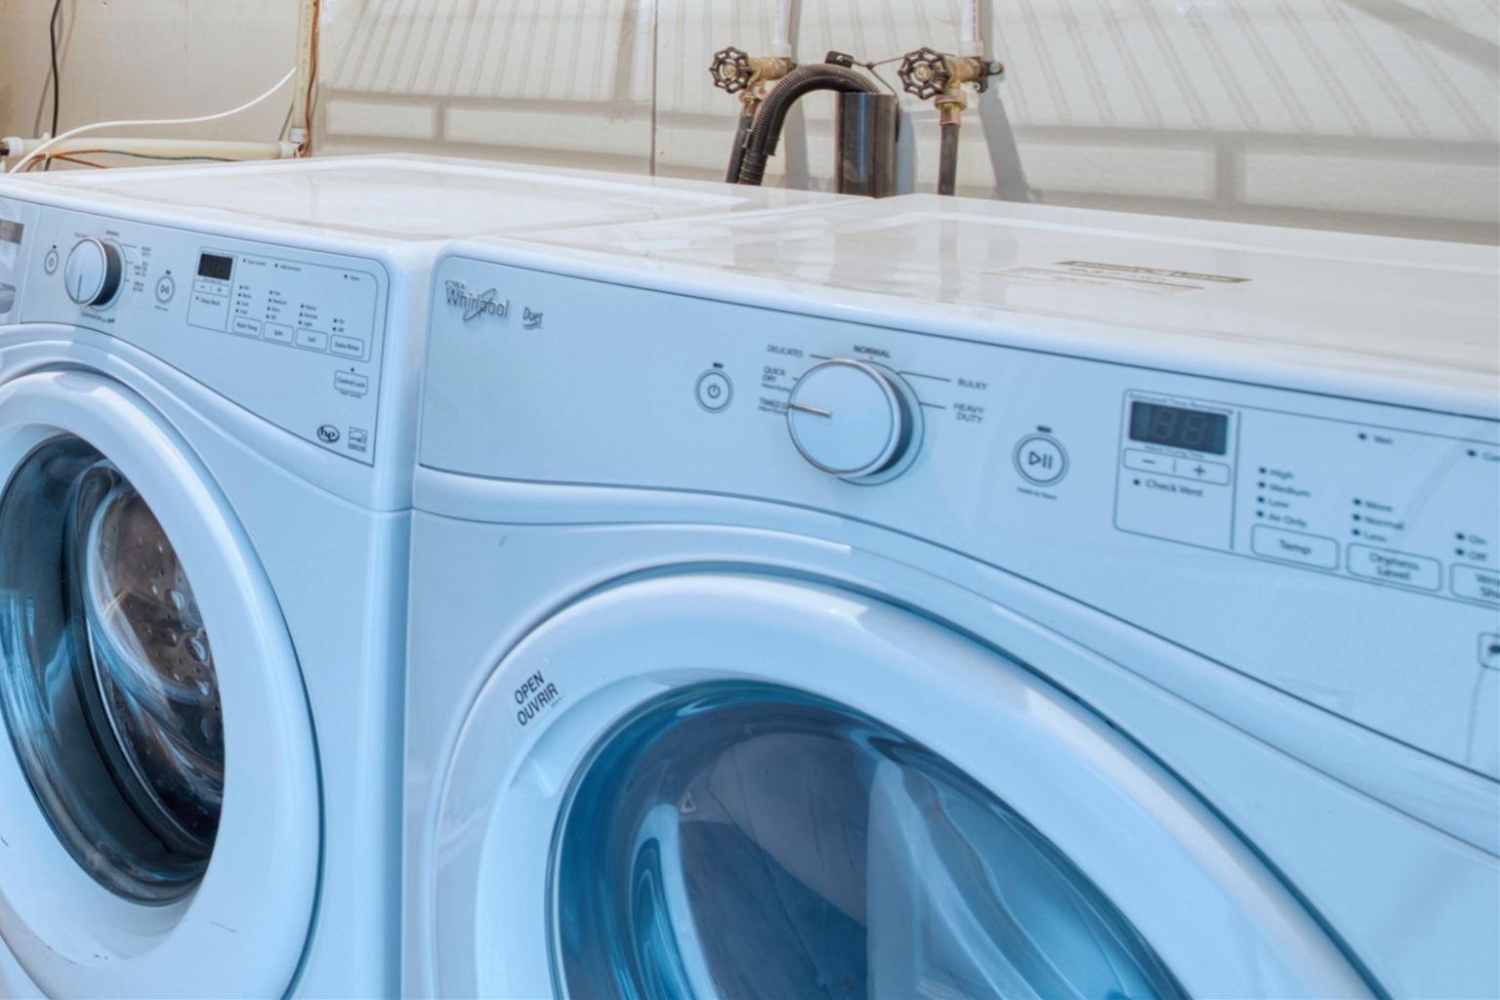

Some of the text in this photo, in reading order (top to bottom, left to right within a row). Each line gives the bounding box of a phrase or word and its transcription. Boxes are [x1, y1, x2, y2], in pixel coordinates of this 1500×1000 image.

[445, 280, 511, 322] Whirlpool
[766, 345, 804, 358] DELICATES
[853, 344, 892, 359] NORMAL
[762, 374, 777, 384] DRY
[763, 366, 787, 377] QUICK
[957, 377, 990, 391] BULKY
[952, 402, 986, 415] HEAVY
[956, 413, 984, 425] DUTY
[1269, 466, 1295, 482] High
[1146, 477, 1204, 499] Check Vent
[1268, 481, 1312, 499] Medium
[1267, 496, 1291, 510] Low
[1364, 499, 1394, 514] More
[1267, 511, 1308, 530] Air Only
[1363, 514, 1406, 532] Normal
[1363, 529, 1389, 544] Less
[1278, 539, 1313, 557] Temp
[1368, 551, 1421, 573] Dryness
[1377, 564, 1412, 582] Level
[514, 670, 545, 705] OPEN
[517, 682, 559, 726] OUVRIR
